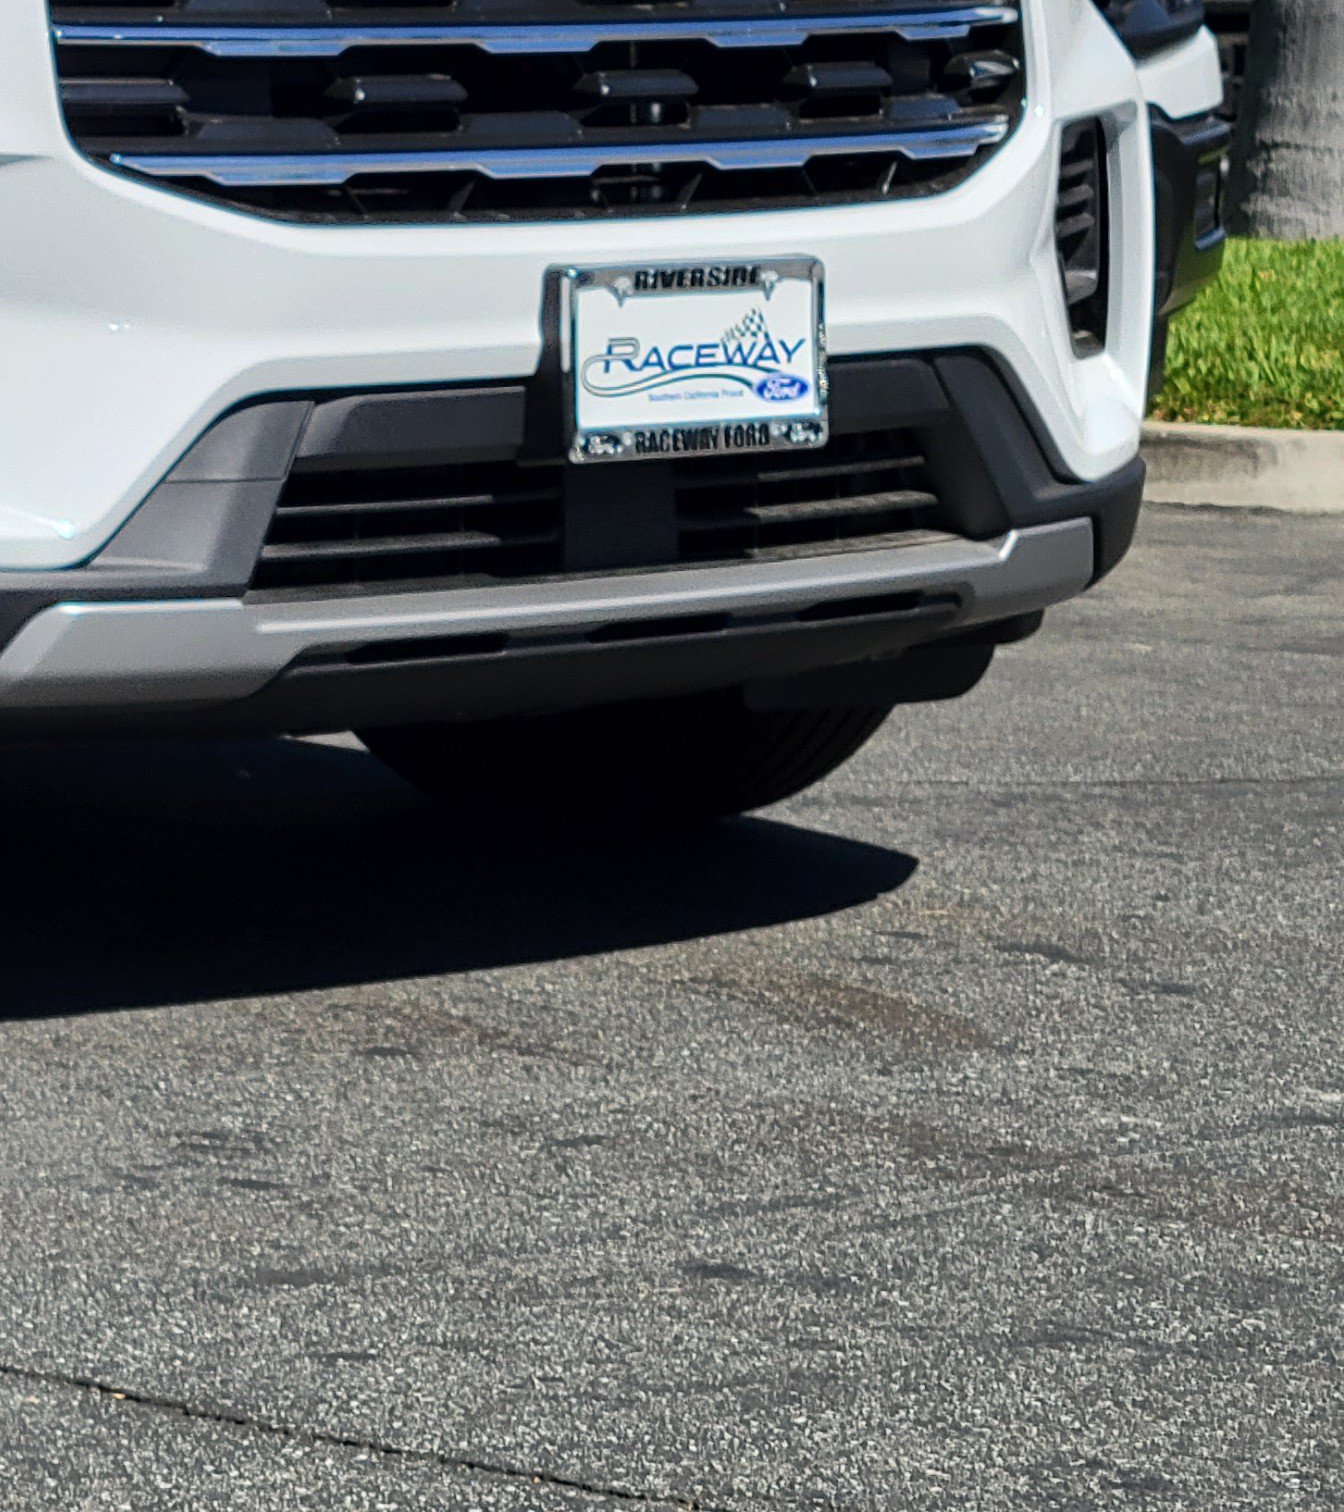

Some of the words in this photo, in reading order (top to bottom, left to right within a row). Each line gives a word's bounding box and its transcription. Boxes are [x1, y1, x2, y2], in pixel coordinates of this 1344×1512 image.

[635, 265, 761, 290] RIVERSIDE
[600, 336, 805, 373] RACEWAY
[763, 377, 801, 400] Ford
[635, 425, 718, 453] RACEWAY
[724, 422, 770, 448] FORD
